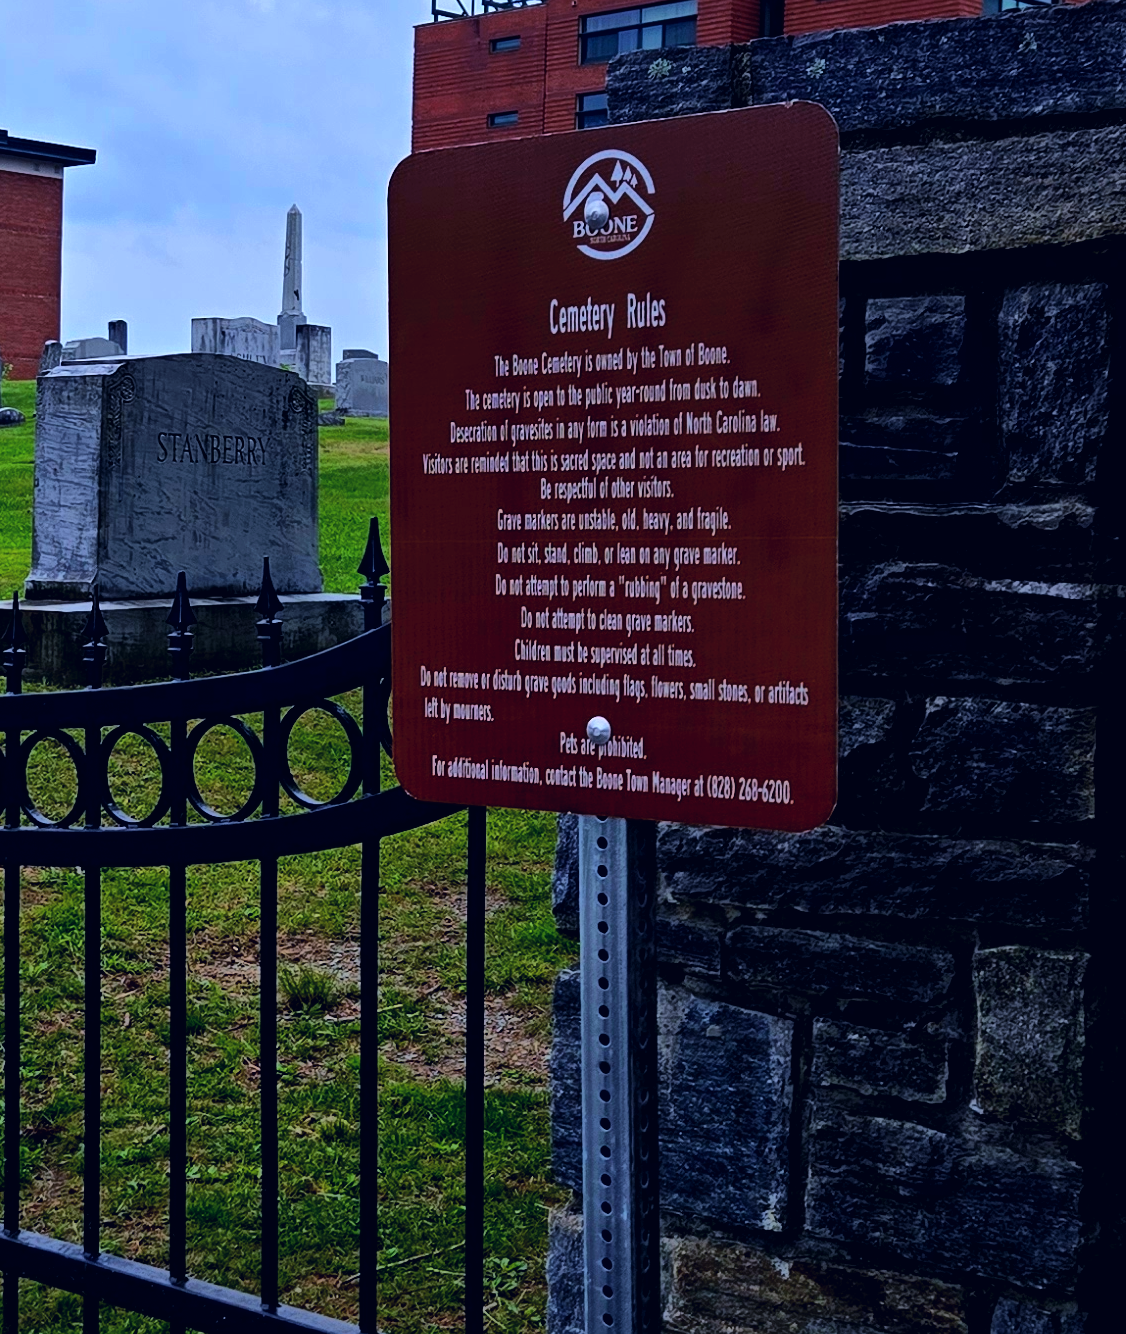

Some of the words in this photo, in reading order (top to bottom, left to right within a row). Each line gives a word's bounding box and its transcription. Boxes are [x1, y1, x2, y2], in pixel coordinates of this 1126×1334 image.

[573, 215, 638, 238] BOONE
[549, 297, 615, 338] Cemetery
[627, 291, 666, 328] Rules
[494, 355, 508, 377] The
[512, 354, 538, 375] Boone
[542, 351, 582, 378] Cemetery
[585, 349, 592, 371] is
[596, 347, 622, 371] owned
[627, 347, 638, 375] by
[641, 346, 655, 368] the
[659, 345, 681, 367] Town
[685, 343, 694, 366] of
[698, 343, 730, 365] Boone.
[465, 389, 479, 410] The
[483, 388, 520, 414] cemetery
[523, 385, 530, 407] is
[533, 390, 553, 413] open
[556, 384, 565, 406] to
[568, 384, 582, 405] the
[586, 382, 612, 411] public
[615, 379, 665, 410] year-round
[669, 379, 690, 400] from
[694, 377, 716, 400] dusk
[719, 377, 728, 398] to
[733, 376, 760, 398] dawn.
[450, 420, 496, 442] Desecration
[500, 419, 508, 441] of
[511, 417, 553, 446] gravesites
[556, 417, 564, 438] in
[567, 421, 584, 444] any
[587, 415, 606, 438] form
[611, 415, 618, 437] is
[621, 419, 626, 436] a
[630, 413, 669, 436] violation
[673, 412, 682, 435] of
[686, 411, 712, 434] North
[716, 410, 756, 433] Carolina
[760, 409, 780, 432] law.
[157, 432, 270, 466] STANBERRY
[423, 453, 452, 474] Visitors
[455, 457, 468, 473] are
[471, 451, 508, 473] reminded
[512, 450, 529, 472] that
[531, 449, 547, 471] this
[550, 449, 558, 471] is
[561, 448, 588, 471] sacred
[592, 452, 616, 475] space
[619, 447, 635, 469] and
[639, 447, 654, 469] not
[656, 451, 667, 468] an
[671, 450, 691, 468] area
[695, 444, 708, 467] for
[712, 443, 759, 467] recreation
[763, 448, 774, 466] or
[777, 442, 805, 471] sport.
[541, 477, 551, 499] Be
[554, 477, 596, 503] respectful
[600, 476, 608, 498] of
[611, 477, 634, 498] other
[638, 475, 674, 498] visitors.
[498, 508, 521, 530] Grave
[525, 508, 558, 530] markers
[561, 513, 575, 530] are
[677, 508, 693, 529] and
[697, 508, 730, 537] fragile.
[497, 542, 508, 563] Do
[511, 542, 525, 563] not
[604, 547, 614, 564] or
[617, 542, 635, 564] lean
[639, 547, 650, 564] on
[653, 547, 670, 571] any
[674, 547, 700, 571] grave
[703, 542, 740, 565] marker.
[495, 573, 506, 595] Do
[509, 574, 523, 595] not
[525, 574, 558, 602] attempt
[560, 574, 569, 596] to
[572, 574, 606, 602] perform
[609, 580, 614, 597] a
[619, 575, 666, 604] "rubbing"
[670, 576, 679, 598] of
[682, 581, 688, 598] a
[691, 577, 745, 605] gravestone.
[521, 605, 532, 628] Do
[536, 606, 549, 628] not
[551, 607, 584, 635] attempt
[587, 607, 596, 630] to
[599, 608, 622, 630] clean
[626, 613, 651, 637] grave
[654, 610, 694, 632] markers.
[515, 638, 550, 661] Children
[554, 641, 574, 662] must
[578, 641, 588, 663] be
[591, 642, 637, 669] supervised
[640, 643, 650, 665] at
[652, 643, 664, 665] all
[667, 643, 696, 667] times.
[420, 665, 431, 686] Do
[434, 666, 447, 687] not
[449, 671, 478, 689] remove
[481, 672, 490, 689] or
[493, 668, 521, 691] disturb
[525, 675, 548, 697] grave
[551, 672, 576, 698] goods
[579, 672, 620, 701] including
[690, 678, 714, 700] small
[754, 685, 765, 703] or
[768, 680, 808, 705] artifacts
[425, 696, 438, 718] left
[441, 698, 450, 726] by
[454, 703, 493, 721] mourners.
[560, 731, 578, 754] Pets
[580, 737, 596, 756] are
[598, 735, 648, 762] prohibited.
[432, 754, 445, 776] For
[447, 756, 488, 779] additional
[545, 764, 576, 787] contact
[579, 765, 593, 788] the
[596, 766, 623, 790] Boone
[626, 768, 648, 792] Town
[652, 770, 691, 800] Manager
[694, 774, 704, 797] at
[707, 774, 735, 799] (828)
[739, 776, 794, 804] 268-6200.
